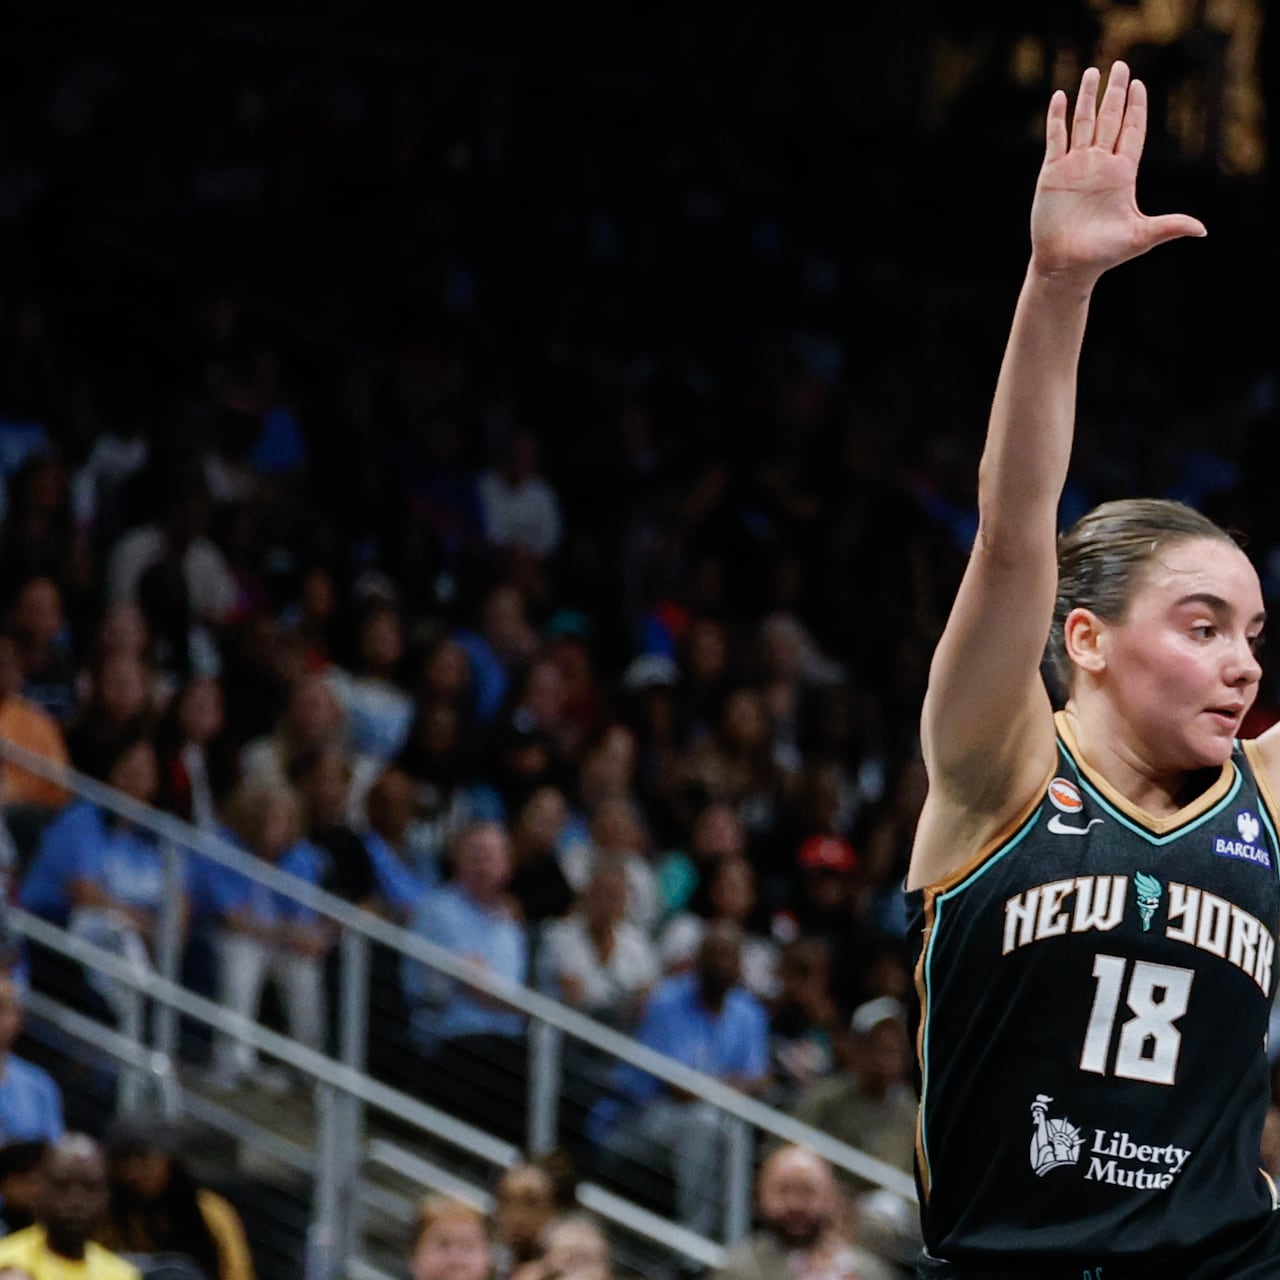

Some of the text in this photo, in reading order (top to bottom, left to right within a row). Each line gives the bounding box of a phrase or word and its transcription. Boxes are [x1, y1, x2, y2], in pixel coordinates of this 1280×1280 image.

[1002, 875, 1276, 999] NEW YORK
[1079, 953, 1196, 1086] 18
[1083, 1156, 1175, 1190] Mutua
[1090, 1128, 1192, 1174] Liberty
